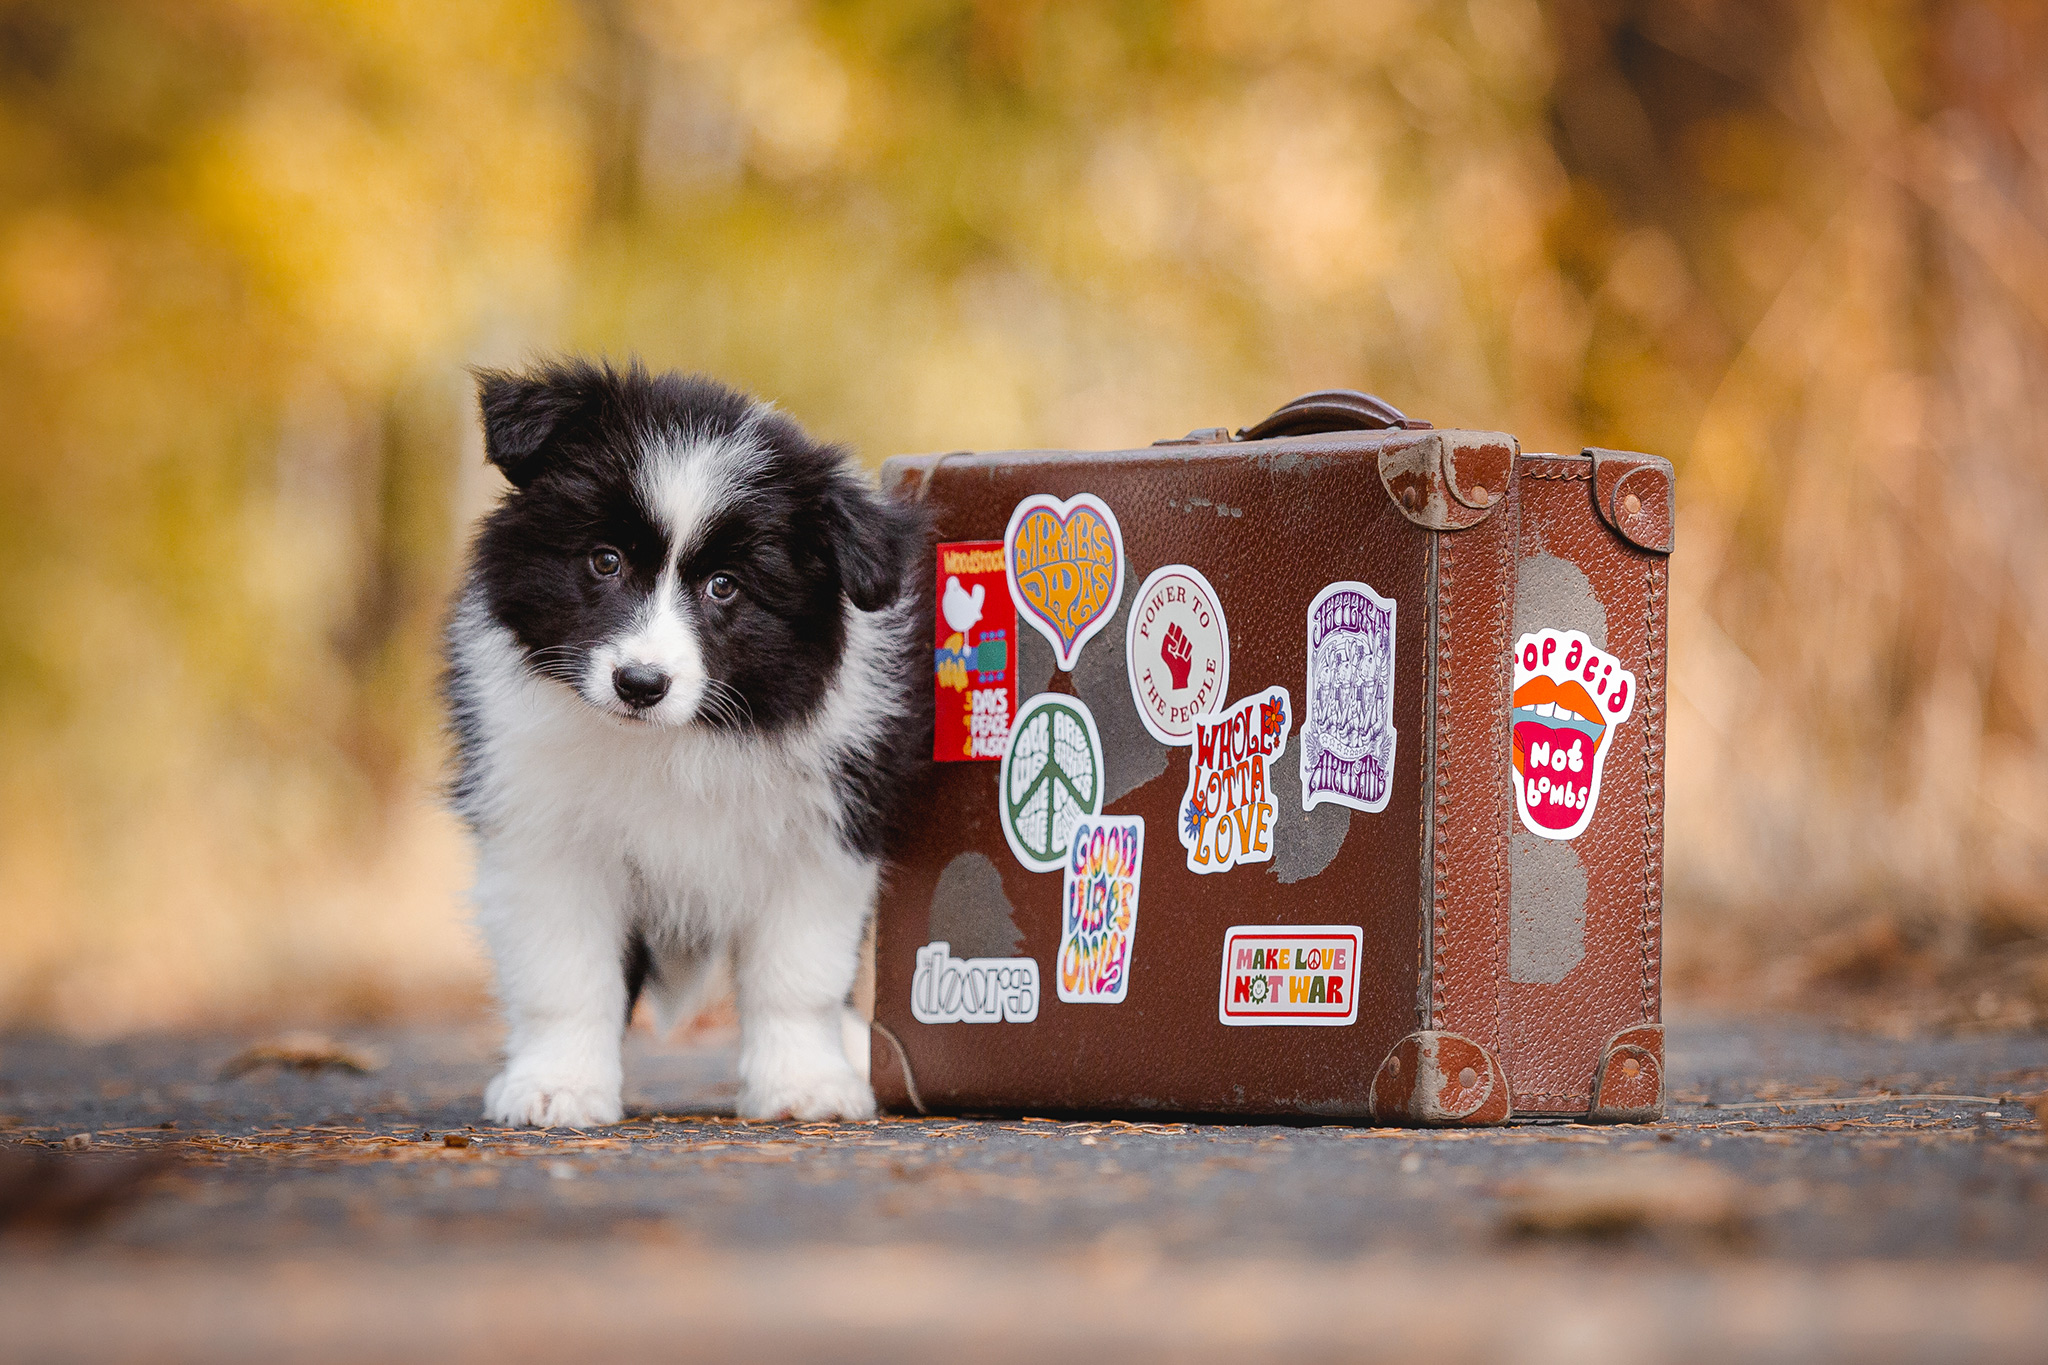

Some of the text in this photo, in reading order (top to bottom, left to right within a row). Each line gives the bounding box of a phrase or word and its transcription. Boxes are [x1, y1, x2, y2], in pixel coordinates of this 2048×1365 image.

[1140, 586, 1211, 640] POWER TO
[1312, 590, 1392, 649] JEFFERSON
[1142, 657, 1217, 724] THE PEOPLE
[1565, 639, 1629, 714] acid
[1197, 703, 1274, 771] WHOLE
[1191, 754, 1266, 819] LOTTA
[1307, 750, 1387, 803] AIRPLANE
[1072, 824, 1138, 878] GOOD
[1193, 802, 1273, 866] LOVE
[1063, 931, 1127, 995] ONLY
[1233, 973, 1344, 1005] NOT WAR
[1236, 948, 1347, 971] MAKE LOVE
